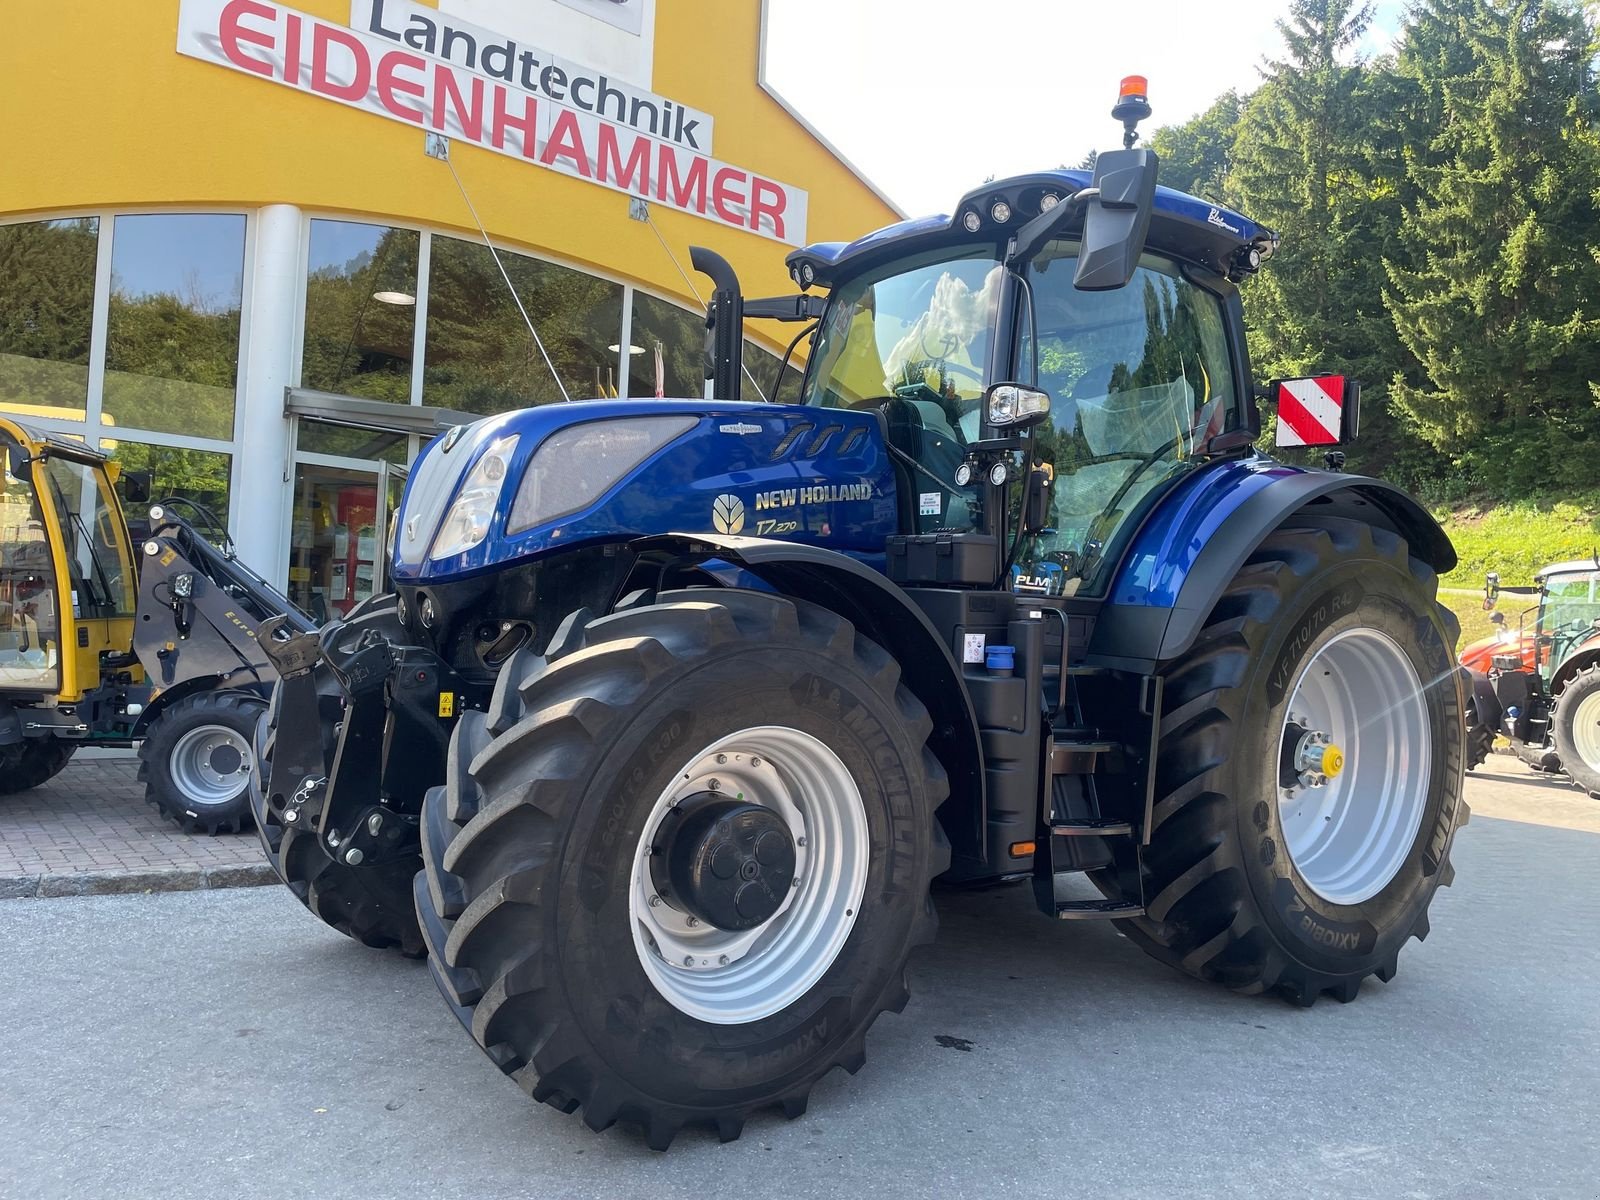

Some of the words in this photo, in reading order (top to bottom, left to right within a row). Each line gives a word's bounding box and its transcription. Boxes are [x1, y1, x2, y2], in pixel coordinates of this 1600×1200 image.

[369, 0, 701, 150] Landtechnik
[218, 0, 787, 240] EIDENHAMMER
[755, 489, 797, 511] NEW
[800, 483, 872, 506] HOLLAND
[756, 519, 797, 536] T7.270
[1015, 575, 1050, 588] PLM
[224, 611, 257, 641] Euro
[1273, 656, 1290, 690] VF
[1289, 606, 1327, 660] 710/70
[844, 703, 916, 890] MICHELIN
[1429, 677, 1462, 866] MICHELIN
[1299, 915, 1361, 950] AXIOBIB
